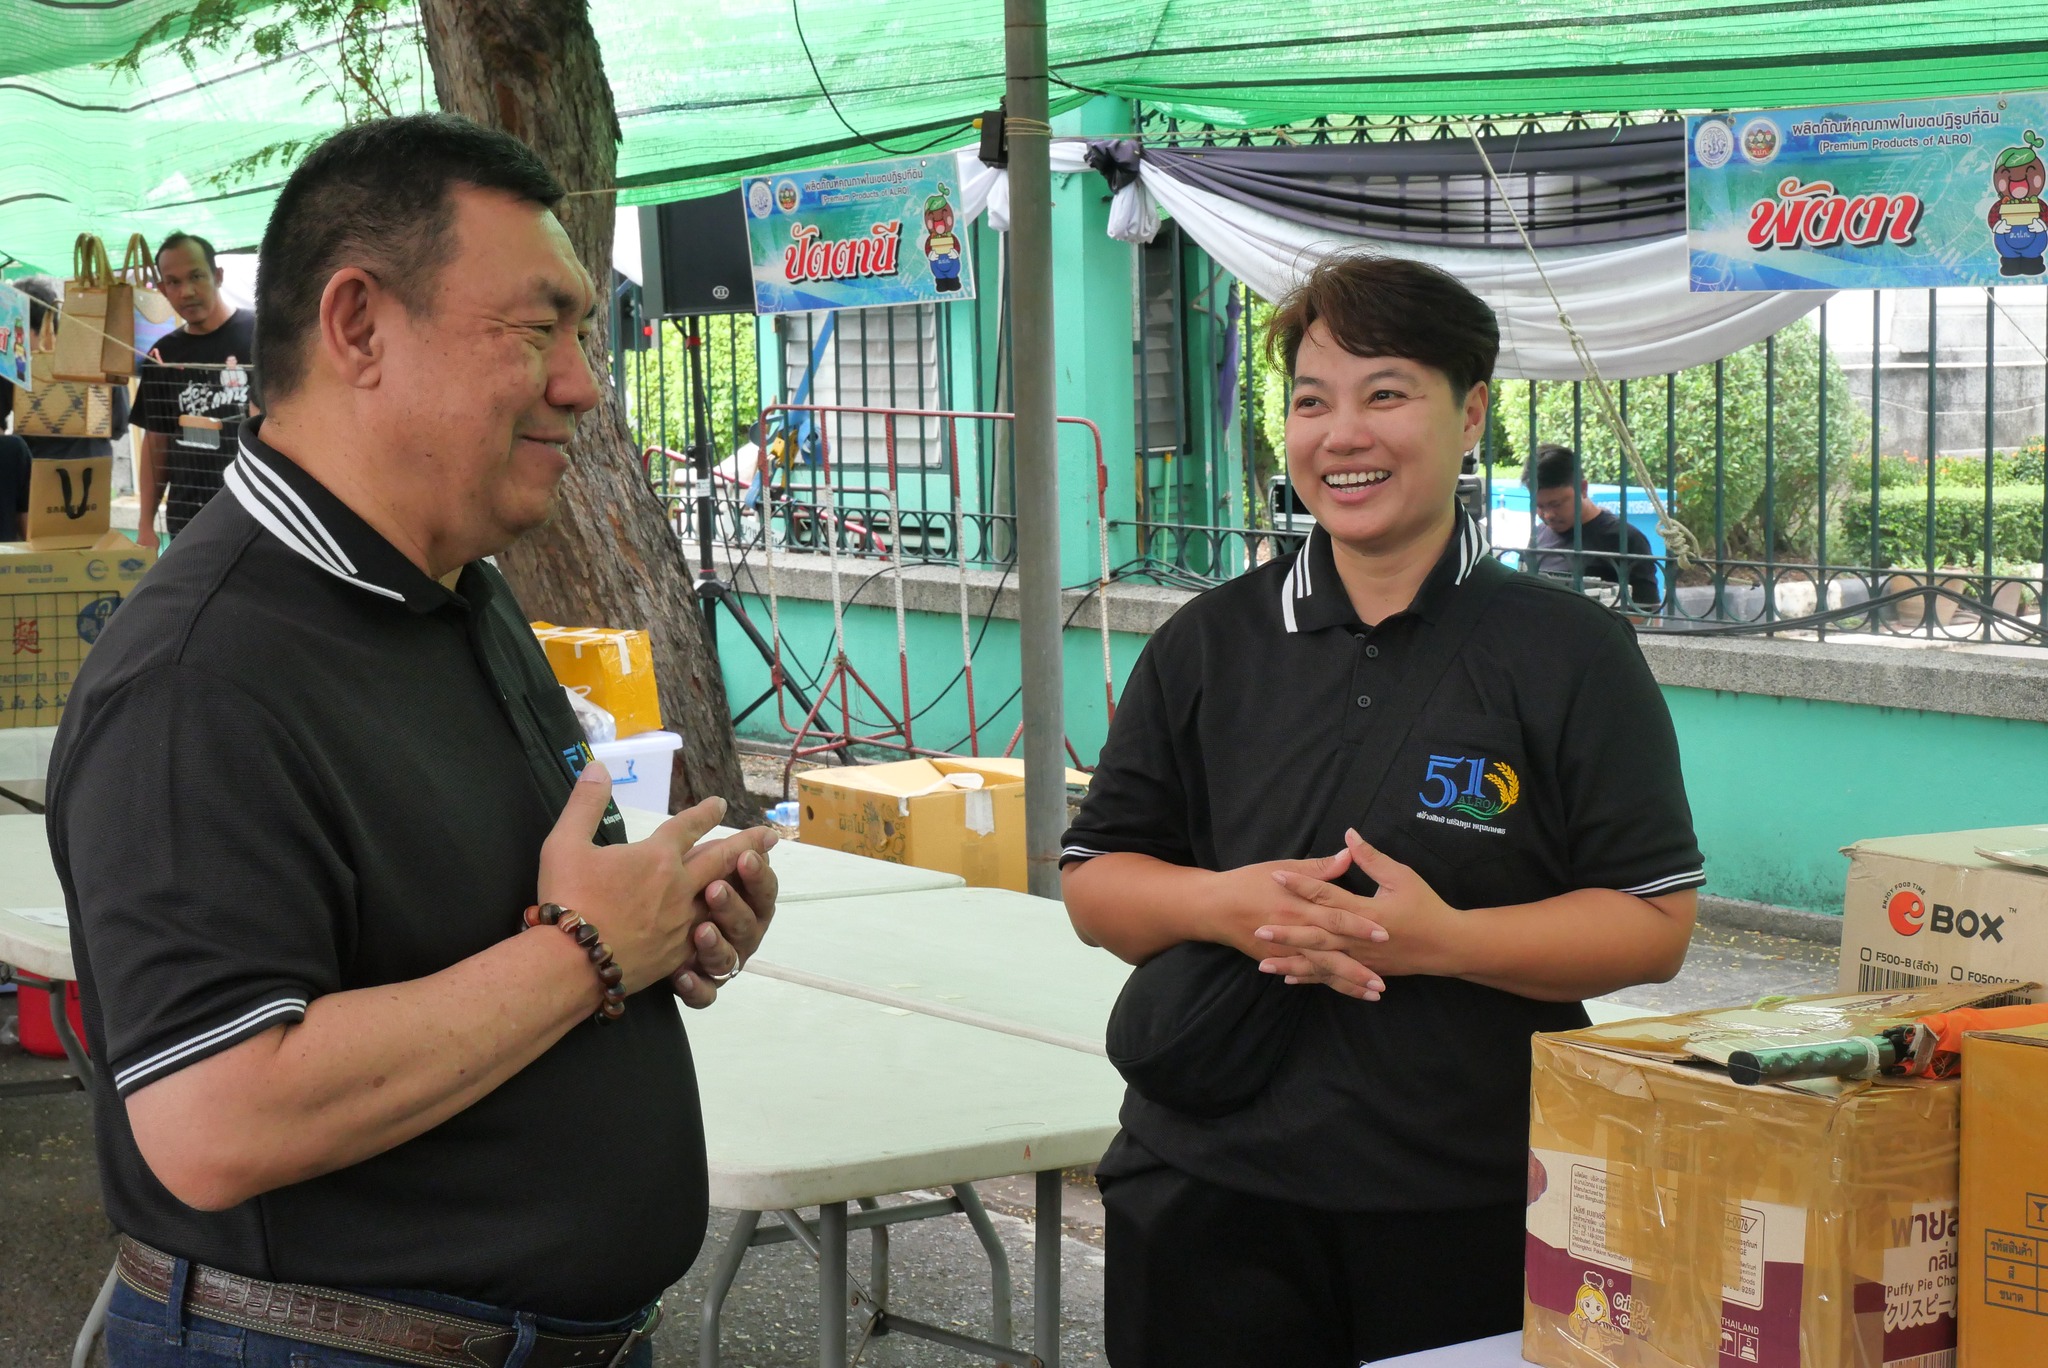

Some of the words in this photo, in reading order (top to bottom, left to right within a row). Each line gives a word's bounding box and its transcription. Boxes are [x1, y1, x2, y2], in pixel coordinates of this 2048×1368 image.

[1792, 107, 1999, 135] ผลิตภัณฑ์คุณภาพในเขตปฏิรูปที่ดิน
[1819, 141, 1868, 153] (Premium
[1872, 137, 1919, 149] Products
[1923, 135, 1934, 146] of
[1937, 133, 1972, 145] ALRO)
[804, 168, 923, 191] ผลิตภัณฑ์คุณภาพในเขตปฏิรูปที่ดิน
[822, 194, 850, 205] (Premium
[852, 190, 879, 200] Products
[881, 189, 888, 197] of
[1748, 178, 1917, 246] พังงา
[785, 221, 899, 281] ปัตตานี
[1418, 754, 1487, 808] 51
[1882, 888, 1894, 909] ENJOY
[1895, 882, 1911, 890] FOOD
[1912, 883, 1926, 895] TIME
[1887, 1282, 1914, 1298] Puffy
[1917, 1278, 1933, 1292] Pie
[1613, 1293, 1650, 1321] Crispy
[1721, 1317, 1759, 1335] THAILAND
[1745, 1338, 1752, 1346] 5
